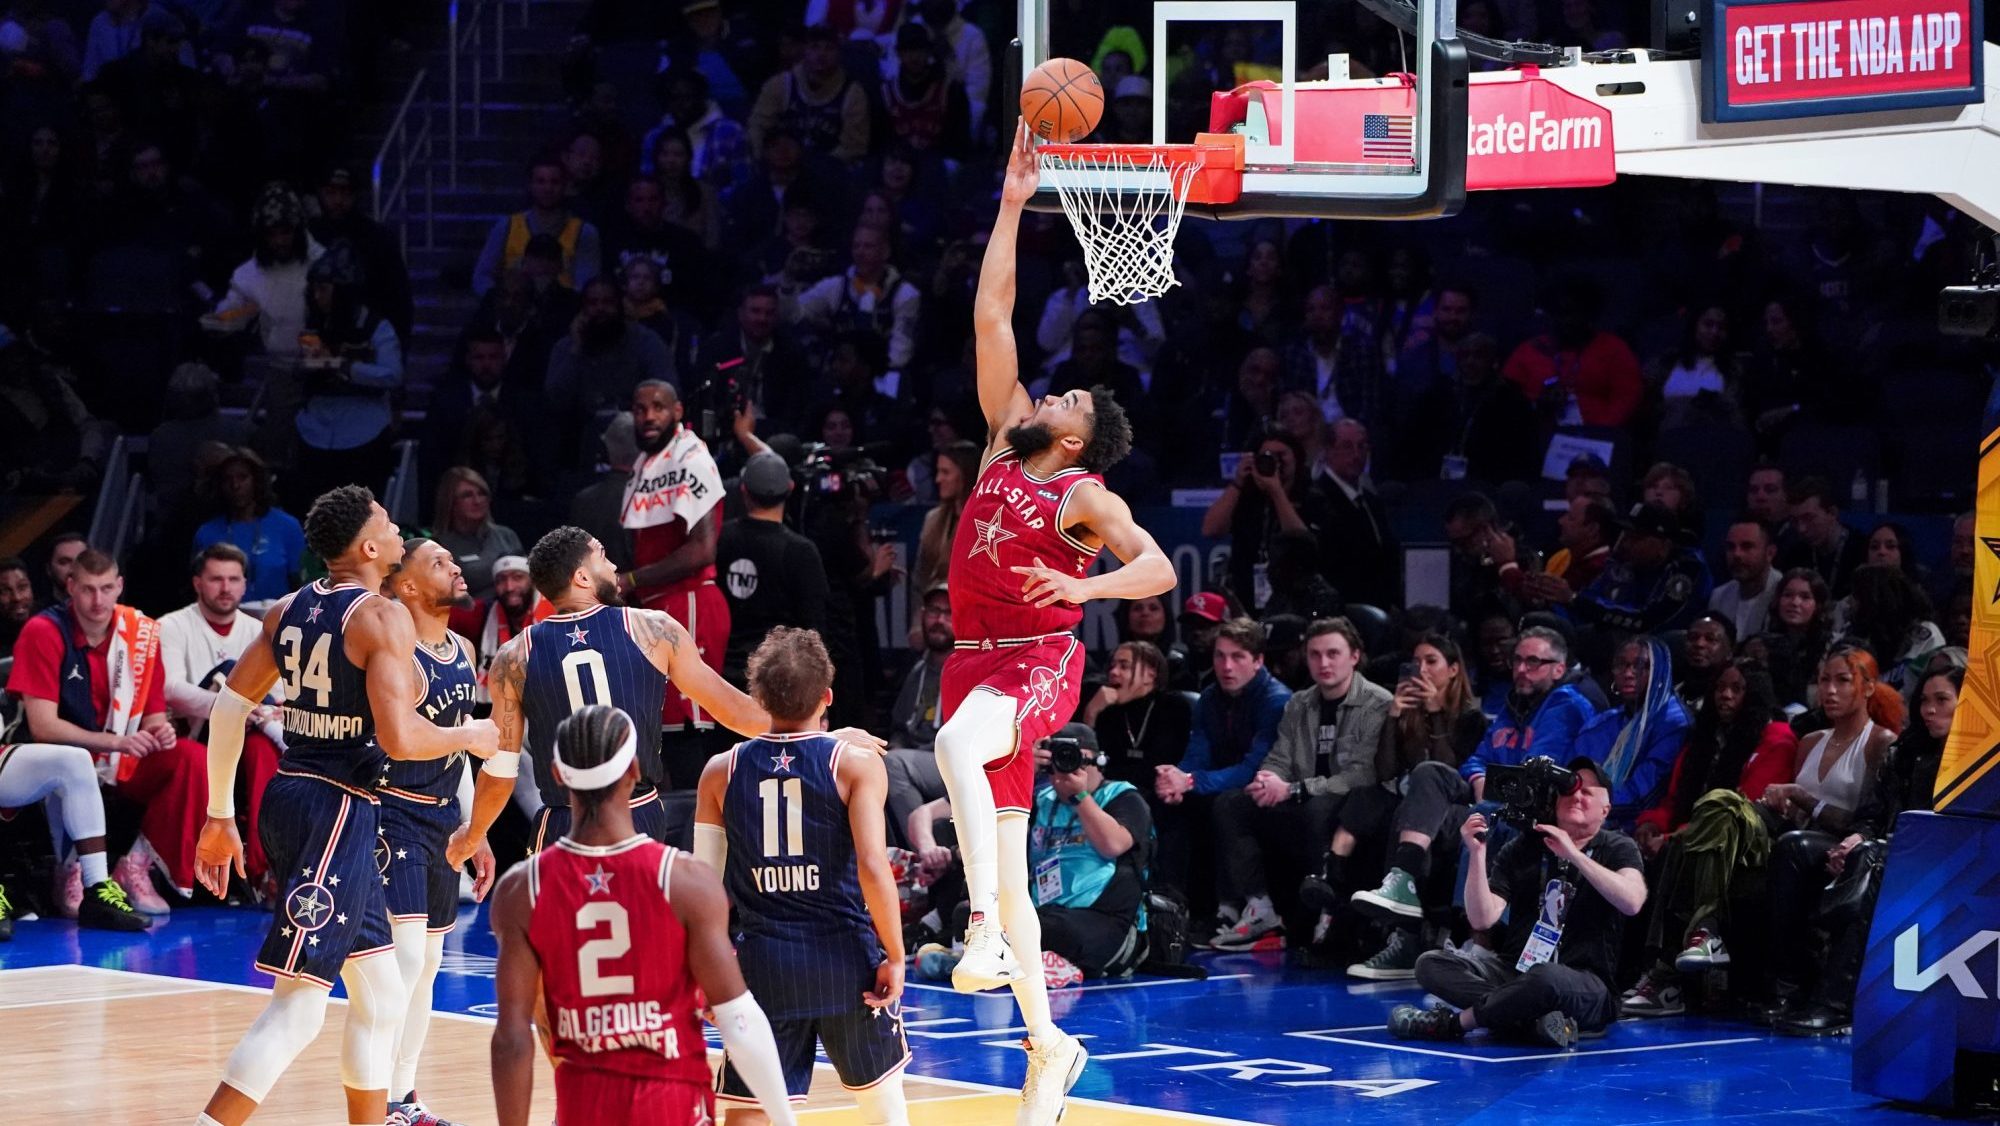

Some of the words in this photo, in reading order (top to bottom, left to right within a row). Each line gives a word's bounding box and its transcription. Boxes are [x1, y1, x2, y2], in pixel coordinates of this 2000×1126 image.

[1735, 24, 1785, 86] GET
[1791, 20, 1843, 81] THE
[1849, 16, 1904, 77] NBA
[1909, 12, 1961, 73] APP
[1467, 113, 1526, 156] tate
[1528, 110, 1602, 152] Farm
[976, 478, 1045, 529] ALL-STAR
[727, 571, 759, 589] TNT
[133, 619, 152, 702] TORADE
[280, 625, 332, 708] 34
[562, 650, 613, 712] 0
[283, 703, 363, 740] TOKOUNMPO
[425, 683, 477, 720] ALL-STA
[759, 778, 803, 857] 11
[752, 864, 820, 893] YOUNG
[576, 901, 634, 997] 2
[1893, 922, 2000, 1001] K
